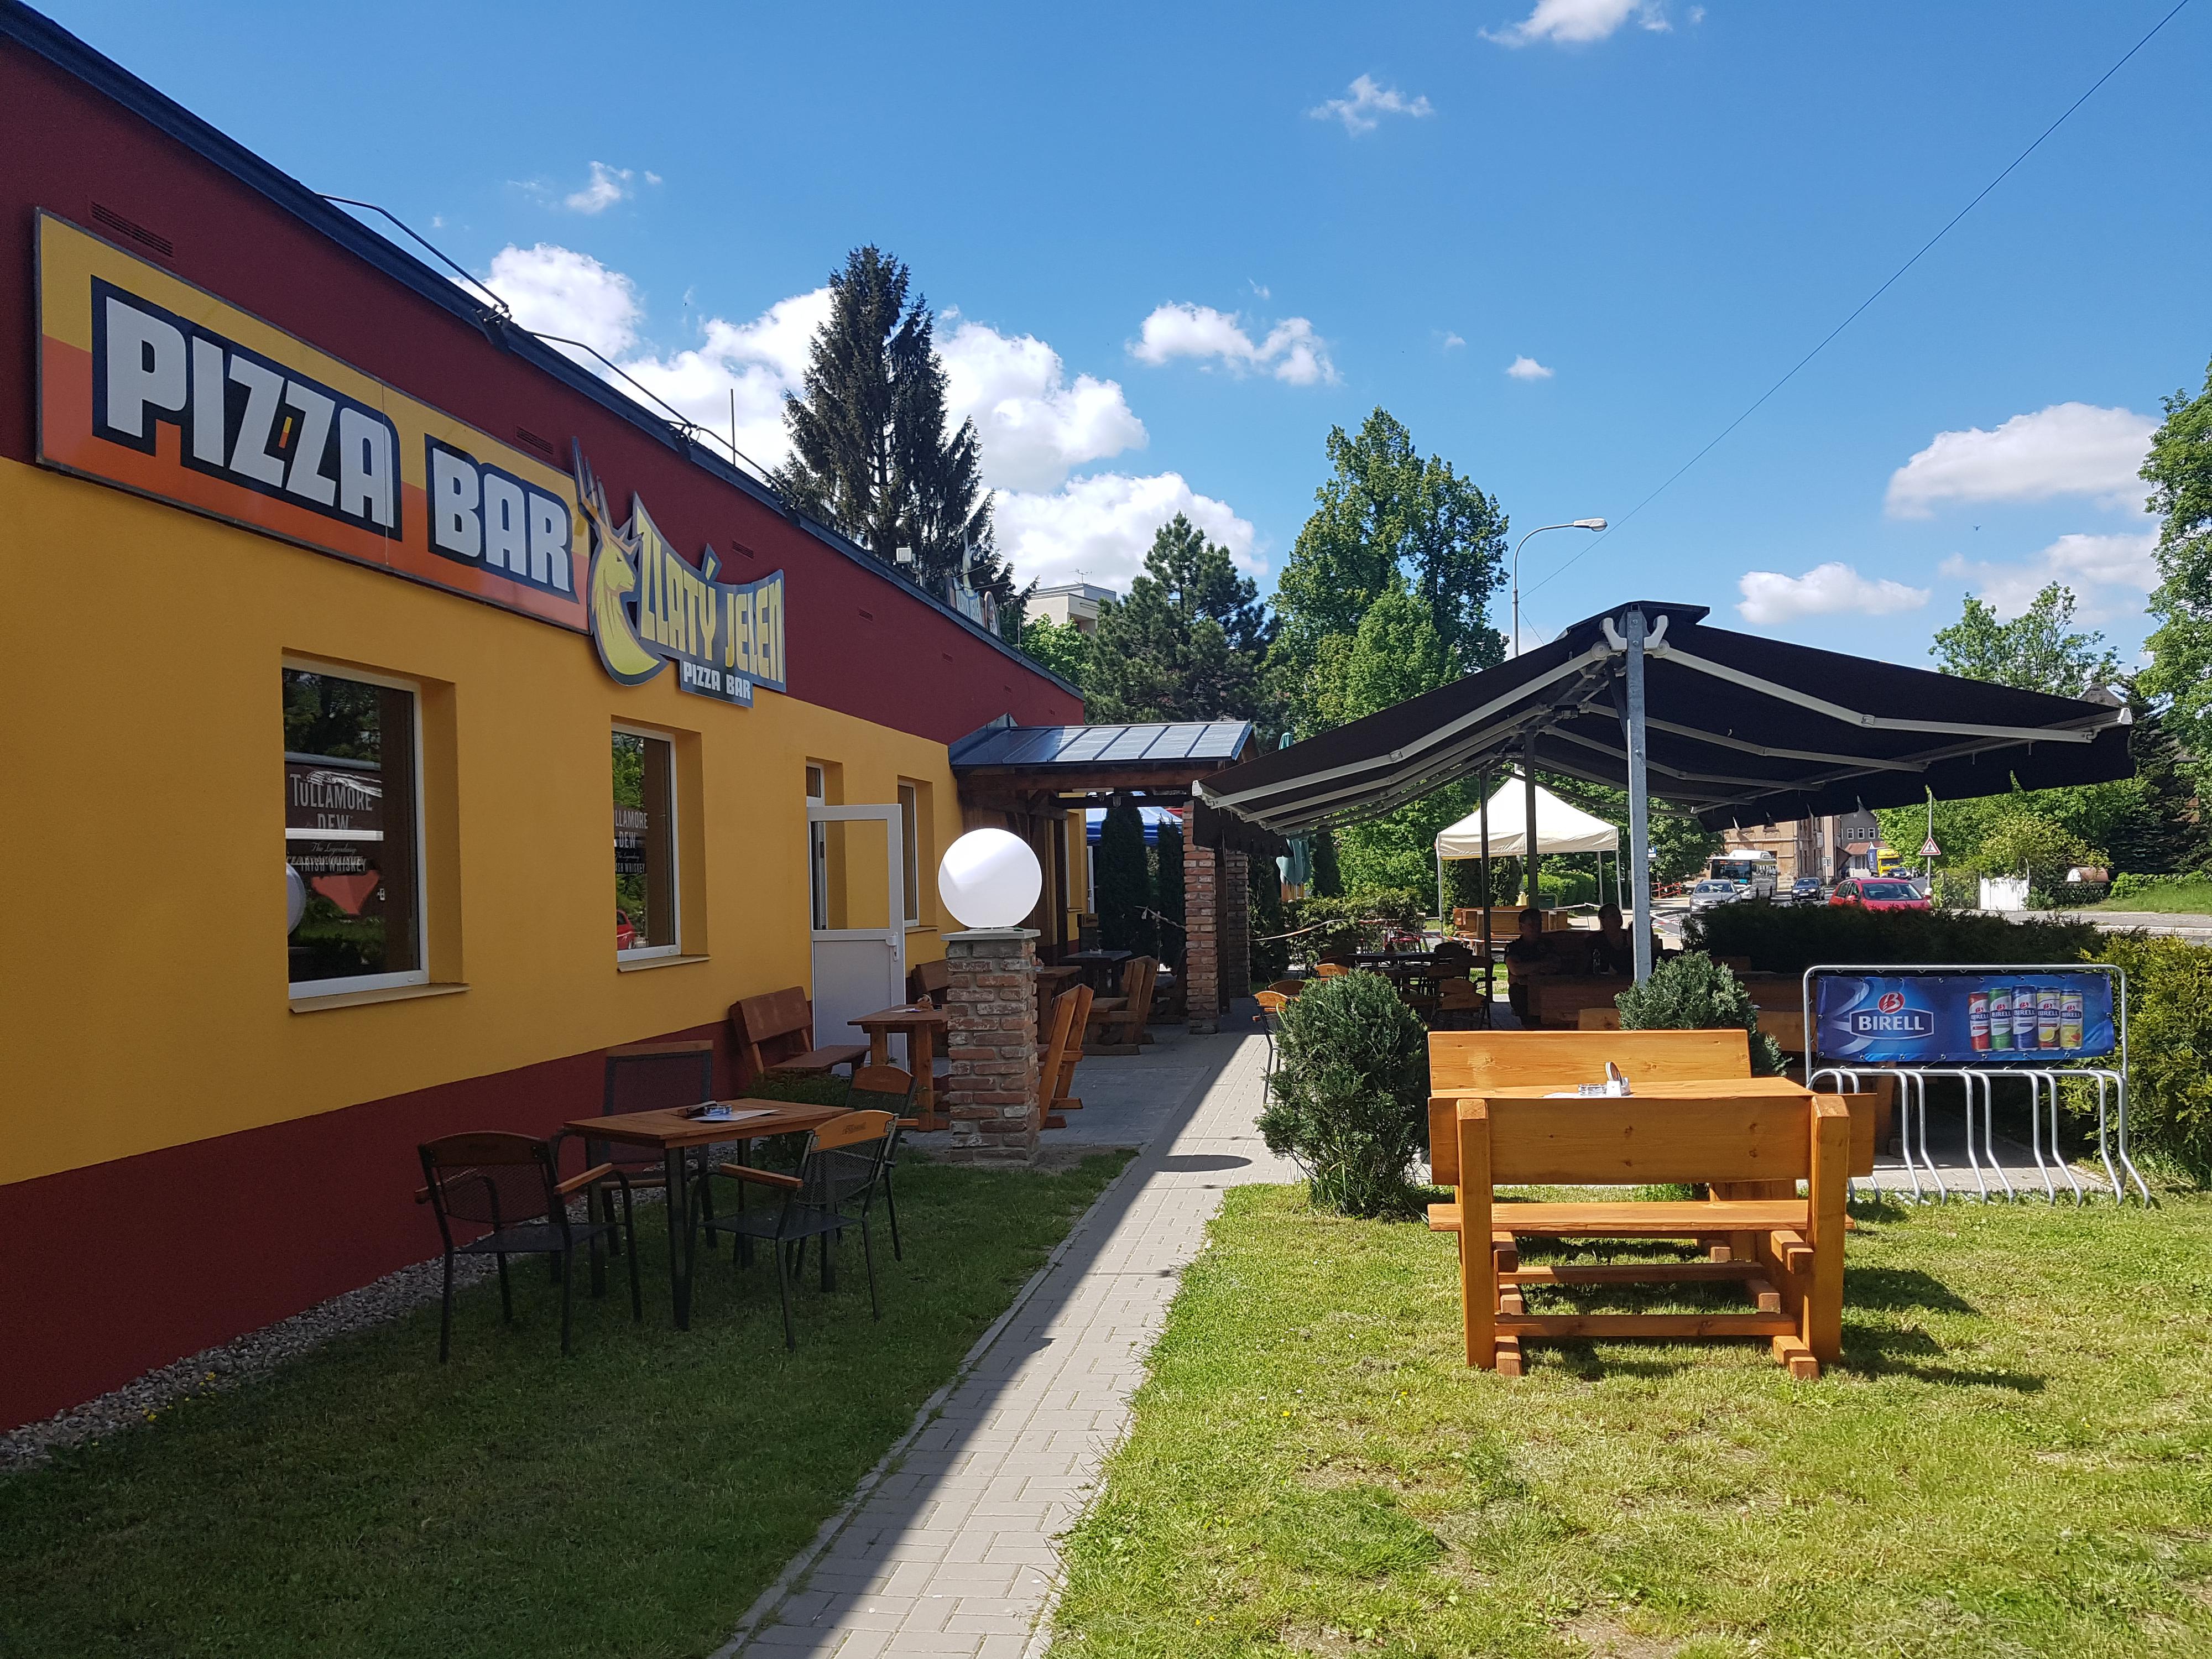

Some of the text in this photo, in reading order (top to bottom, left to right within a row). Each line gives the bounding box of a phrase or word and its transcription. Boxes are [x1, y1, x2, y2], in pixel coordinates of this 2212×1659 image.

[106, 296, 570, 592] PIZZA BAR
[637, 506, 784, 683] ZLATÝ JELEN
[683, 660, 752, 700] PIZZA BAR
[619, 831, 637, 849] DEW
[1859, 1015, 1925, 1031] BIRELL
